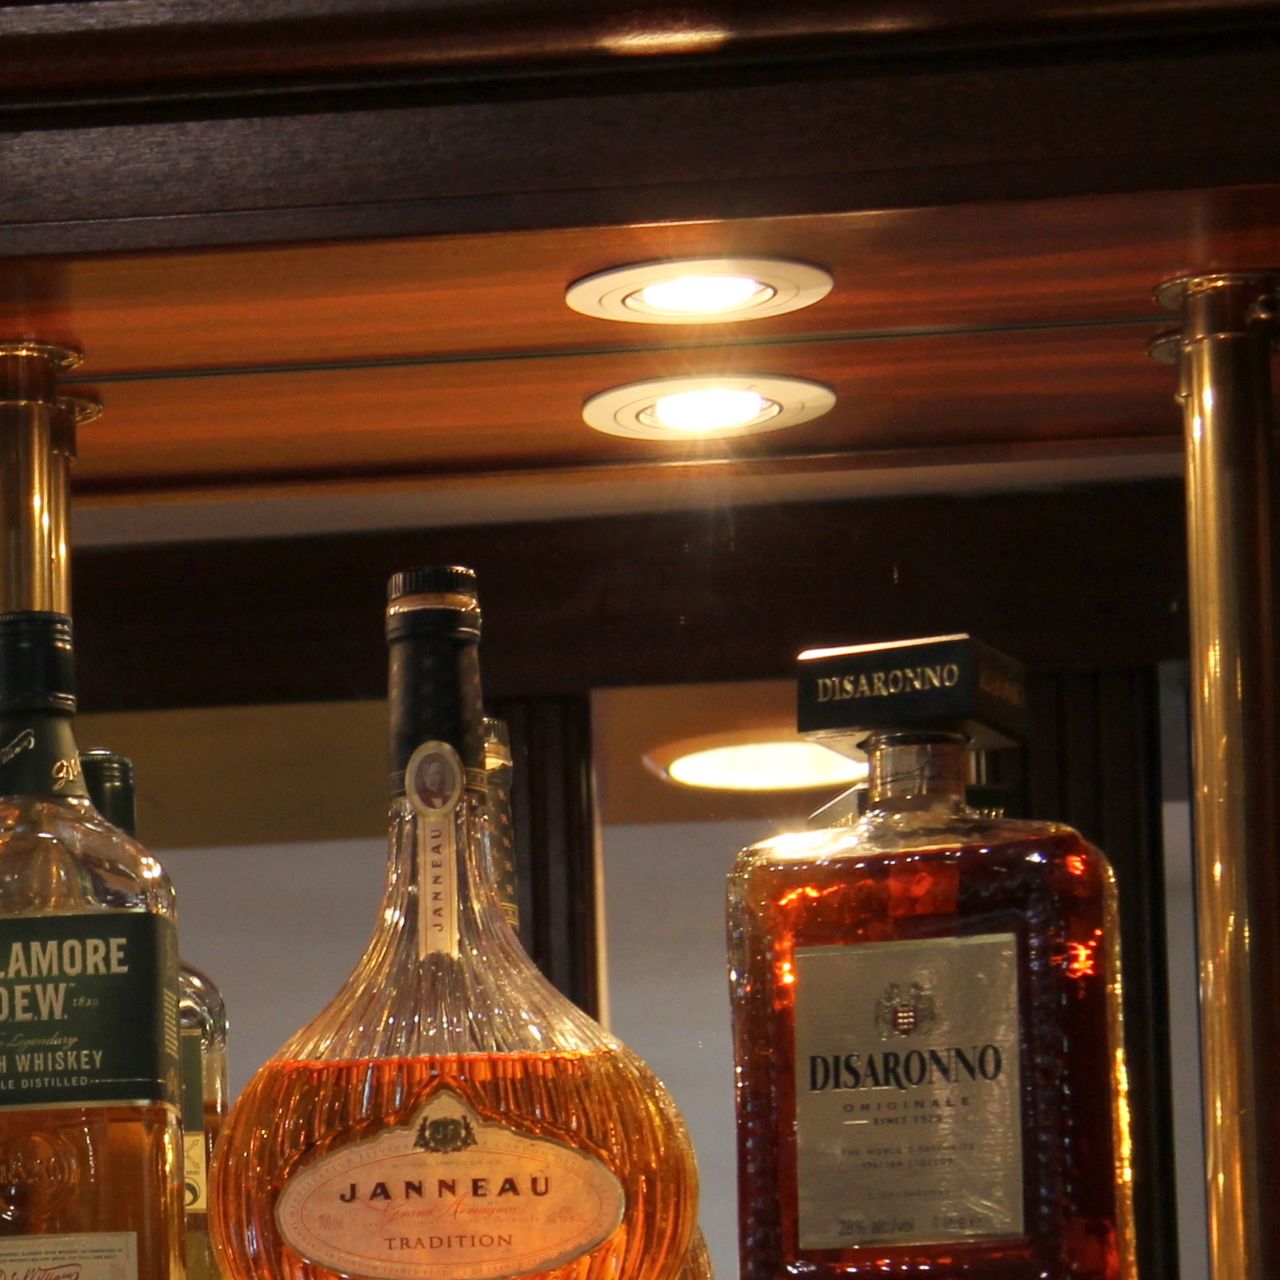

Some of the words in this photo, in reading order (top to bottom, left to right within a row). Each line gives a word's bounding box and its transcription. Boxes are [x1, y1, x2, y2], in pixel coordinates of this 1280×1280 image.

[817, 663, 960, 703] DISARONNO
[432, 828, 444, 933] JANNEAU
[16, 1050, 103, 1073] WHISKEY
[808, 1044, 1003, 1091] DISARONNO
[21, 1075, 88, 1089] DISTILLED
[843, 1096, 972, 1113] ORIGINALE
[339, 1177, 550, 1203] JANNEAU
[383, 1233, 514, 1252] TRADITION
